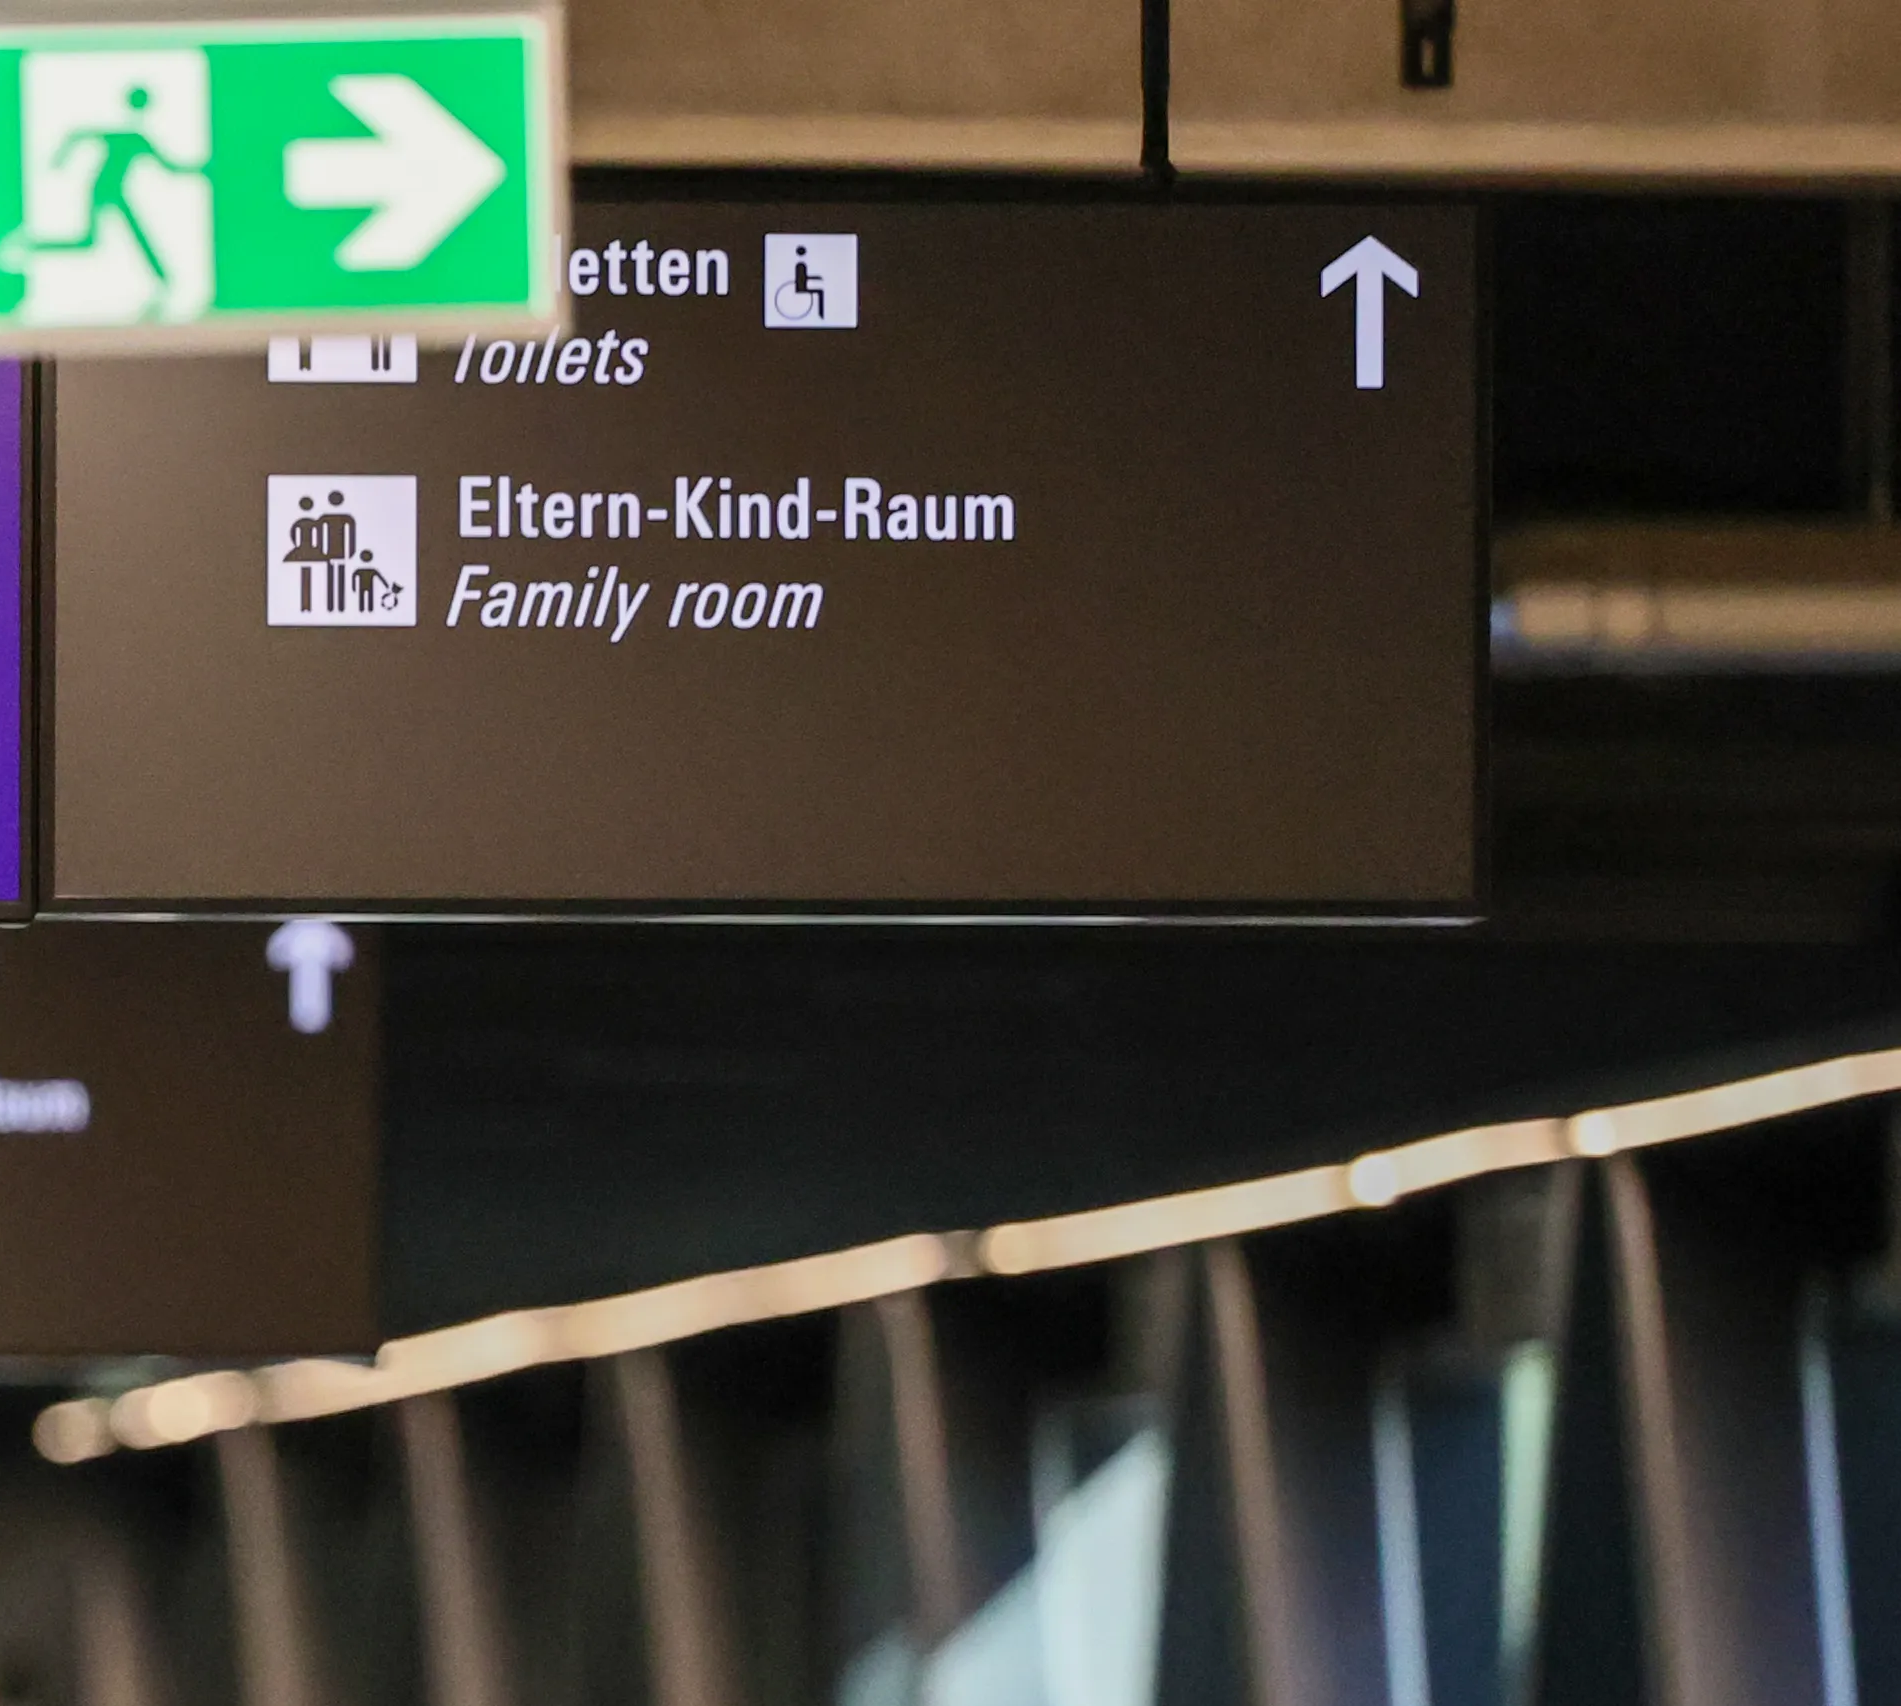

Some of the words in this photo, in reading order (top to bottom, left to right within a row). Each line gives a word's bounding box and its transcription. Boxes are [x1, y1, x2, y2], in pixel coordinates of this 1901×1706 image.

[460, 475, 1014, 540] Eltern-Kind-Raum
[446, 565, 650, 643] Family
[668, 582, 824, 629] room
